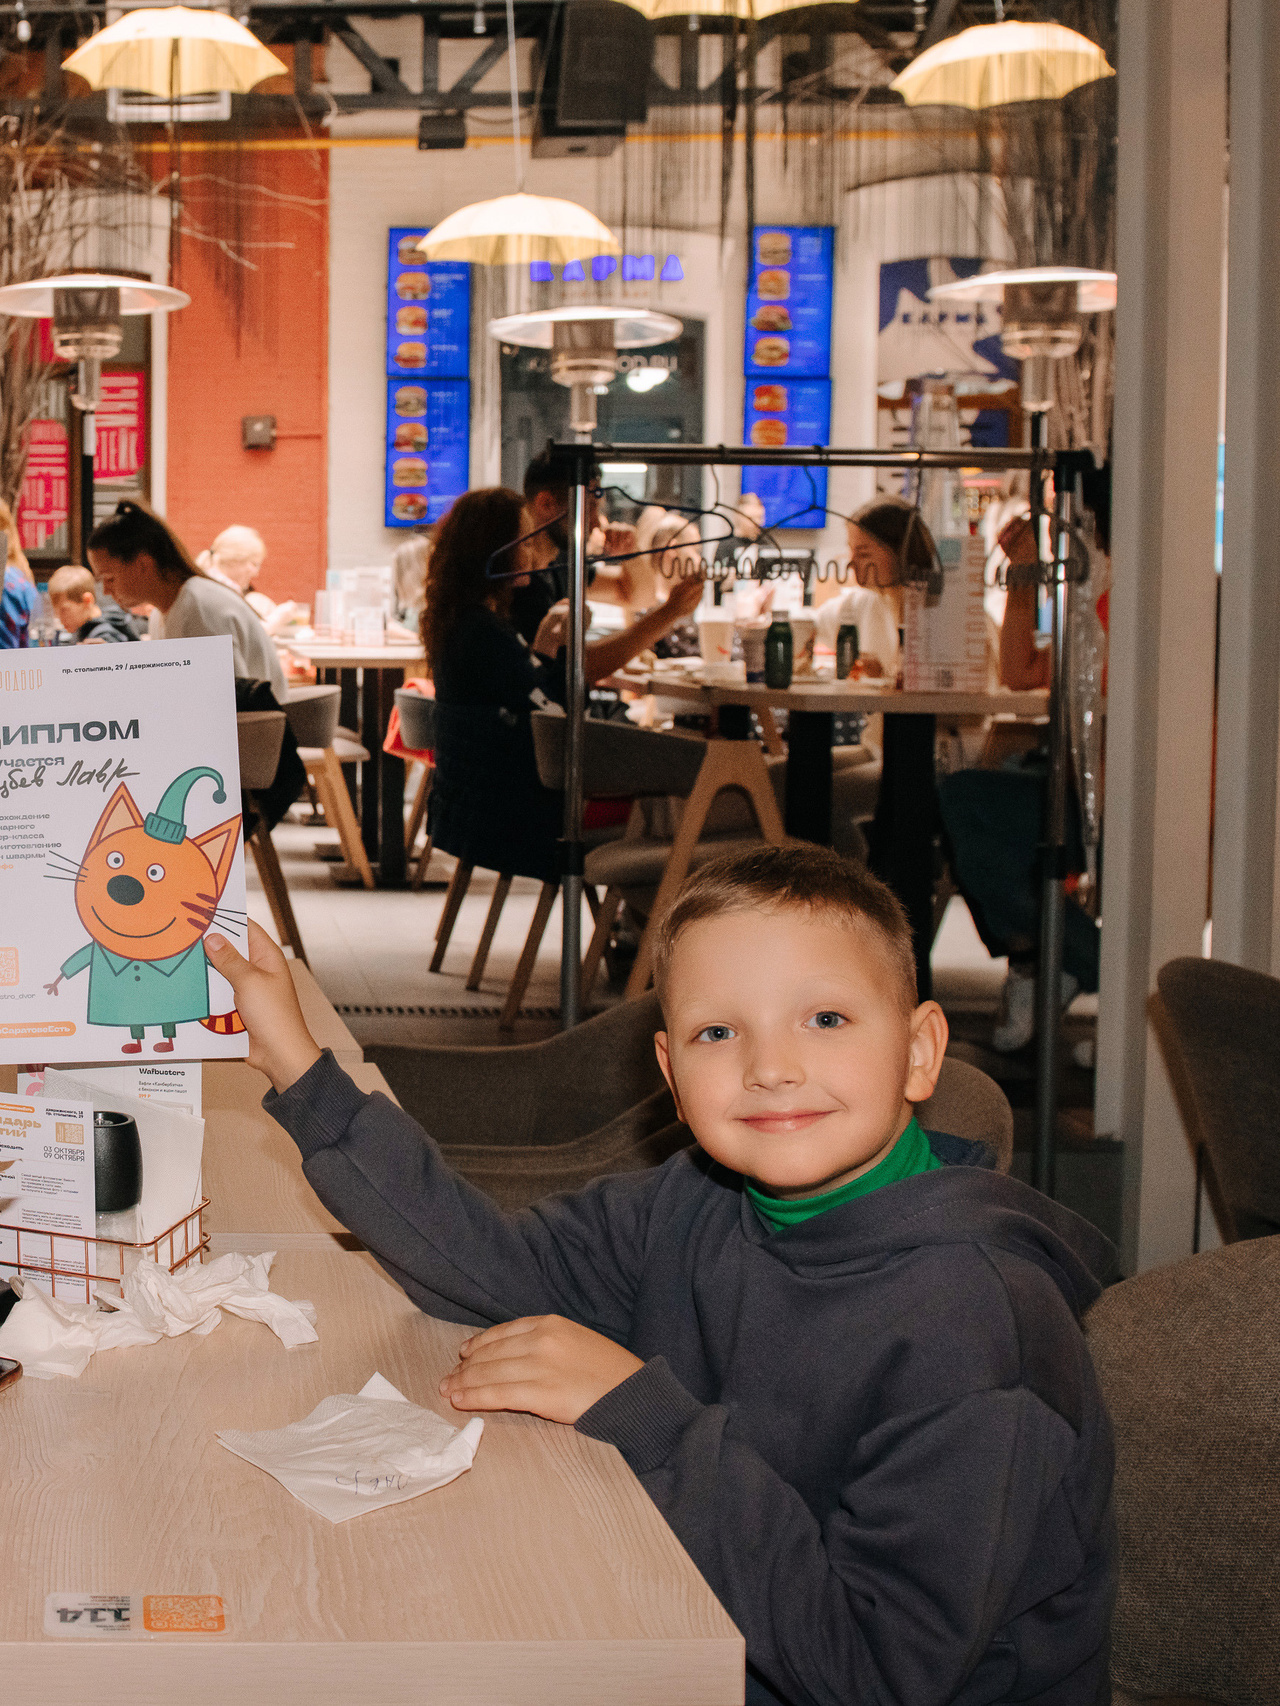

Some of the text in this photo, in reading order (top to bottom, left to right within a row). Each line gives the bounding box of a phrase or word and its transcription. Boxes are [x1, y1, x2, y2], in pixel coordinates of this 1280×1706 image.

[74, 665, 114, 674] столыпина,
[129, 661, 182, 671] дзержинского,
[43, 1145, 85, 1156] 03 ОКТЯБРЯ
[43, 1151, 85, 1162] 09 ОКТЯБРЯ
